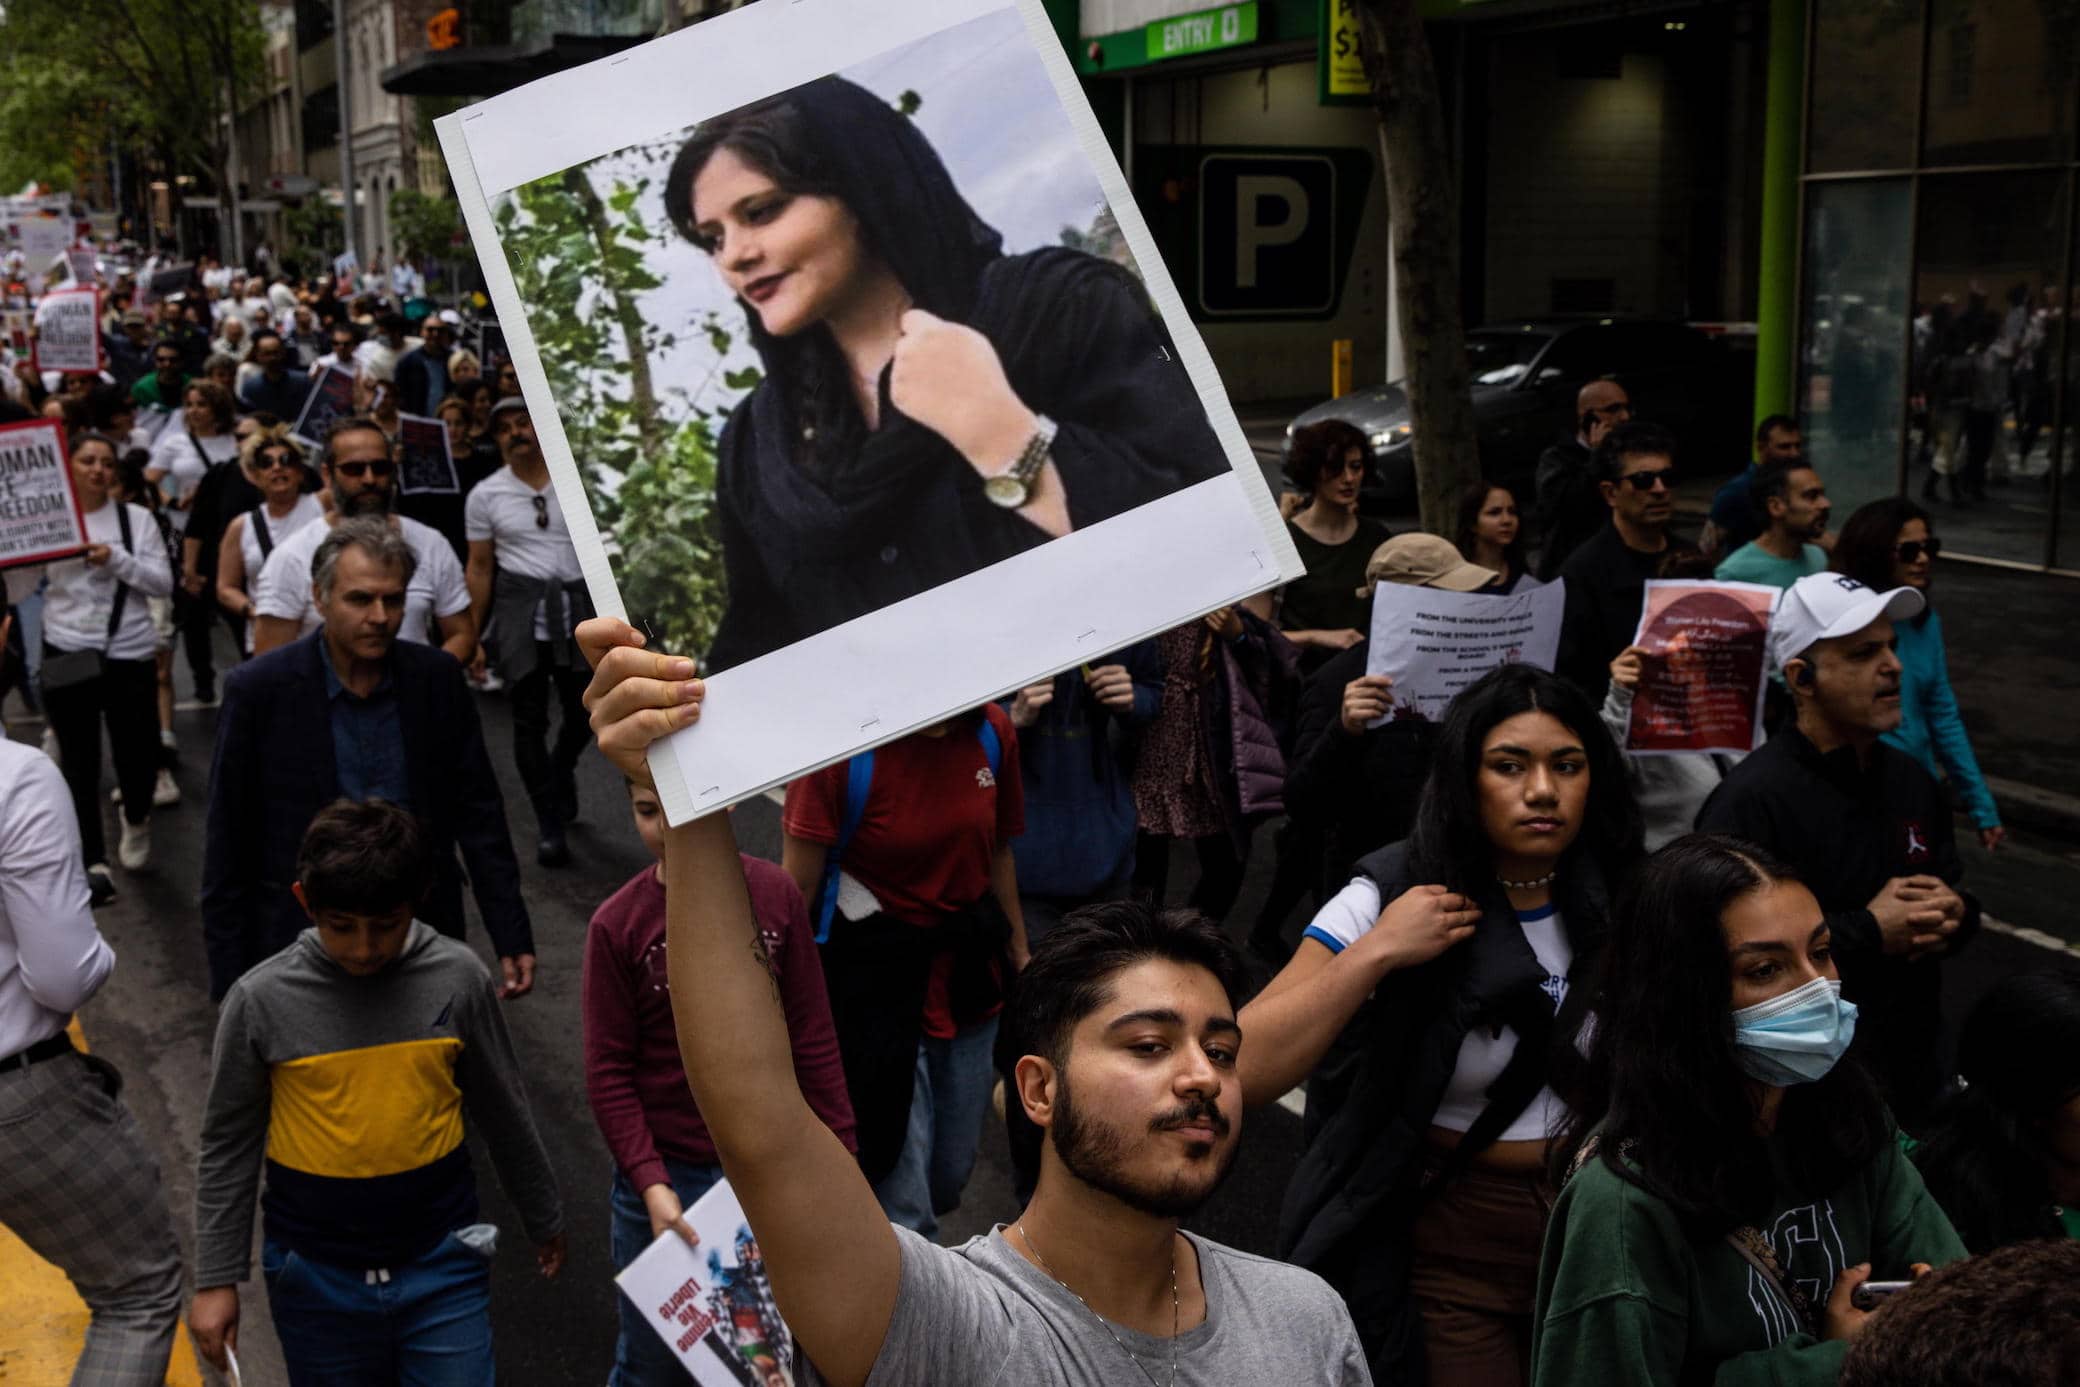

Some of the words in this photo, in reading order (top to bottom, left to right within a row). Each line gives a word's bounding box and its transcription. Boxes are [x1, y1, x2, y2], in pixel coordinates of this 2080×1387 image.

[1164, 16, 1214, 52] ENTRY
[1236, 175, 1310, 289] P
[1416, 612, 1439, 621] FROM
[1442, 615, 1457, 623] THE
[1410, 628, 1434, 637] FROM
